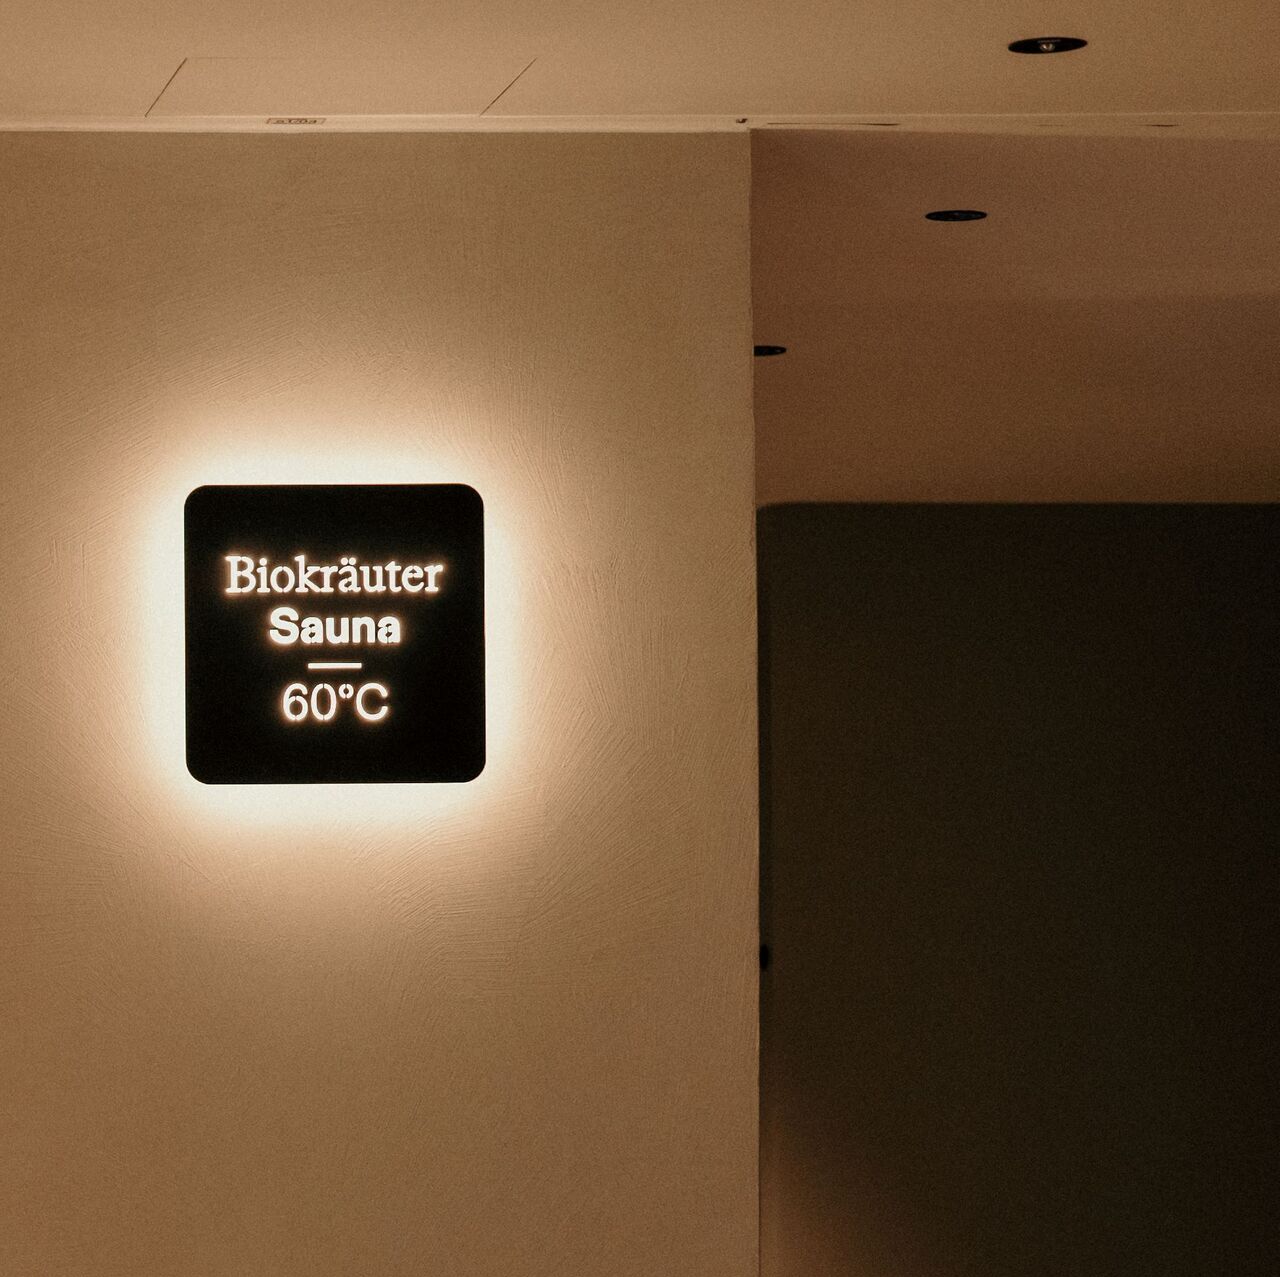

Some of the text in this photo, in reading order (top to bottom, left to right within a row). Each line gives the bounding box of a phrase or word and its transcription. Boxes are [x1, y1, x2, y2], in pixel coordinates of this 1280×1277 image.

[224, 554, 444, 594] Biokräuter
[269, 606, 401, 645] Sauna
[283, 682, 389, 721] 60°C
